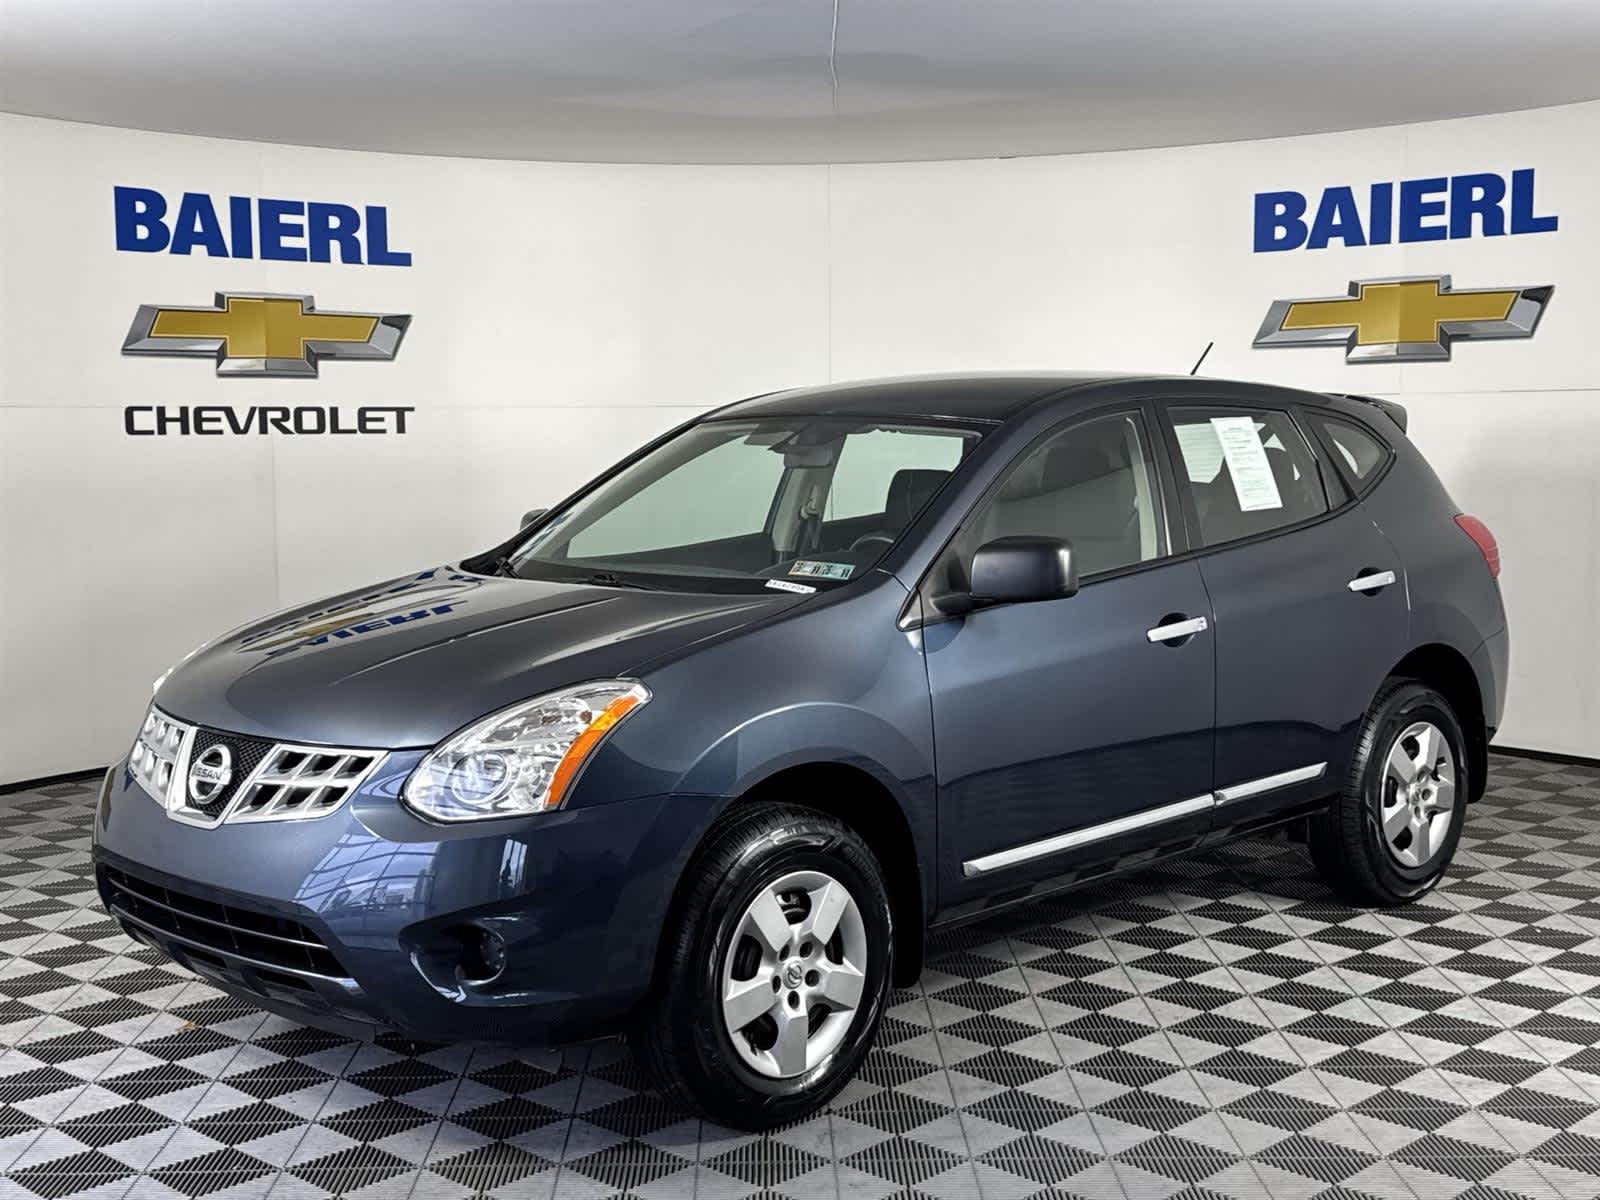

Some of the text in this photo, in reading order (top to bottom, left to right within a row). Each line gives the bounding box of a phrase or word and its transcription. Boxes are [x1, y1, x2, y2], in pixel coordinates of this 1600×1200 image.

[115, 187, 411, 266] BAIERL
[1254, 170, 1557, 252] BAIERL
[125, 406, 415, 435] CHEVROLET
